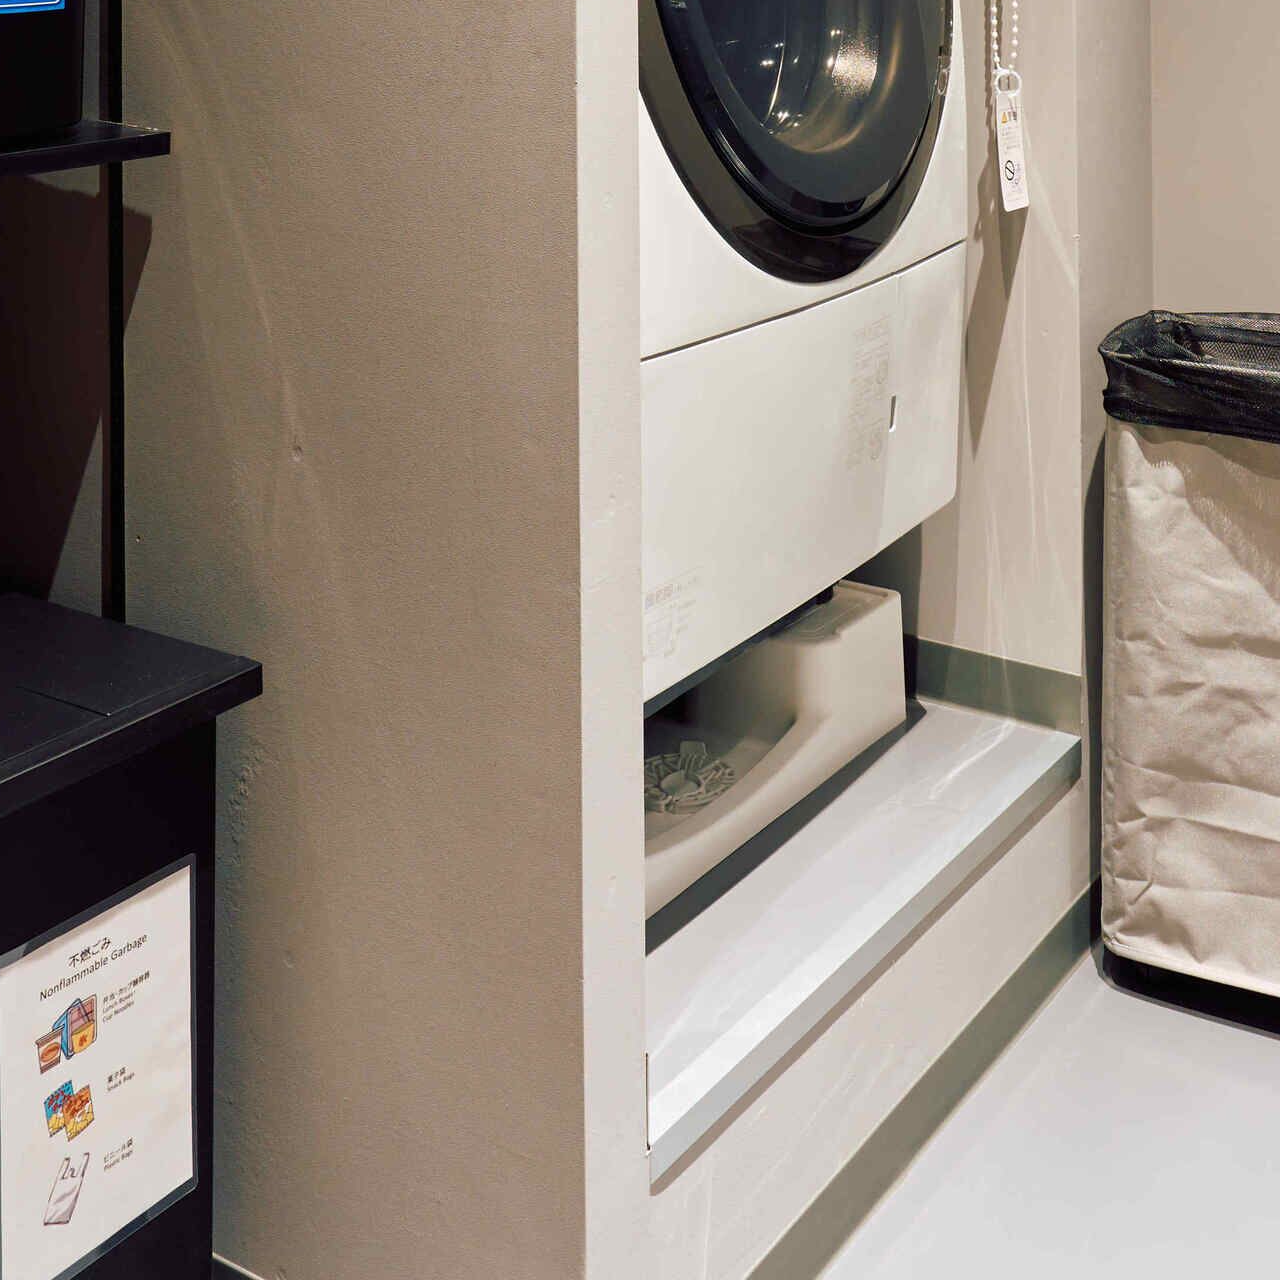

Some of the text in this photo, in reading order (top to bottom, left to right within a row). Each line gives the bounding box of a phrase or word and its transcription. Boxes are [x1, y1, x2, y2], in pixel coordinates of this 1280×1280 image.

[40, 934, 148, 1000] Nonflammable Garbage
[69, 937, 111, 967] 不燃ごみ
